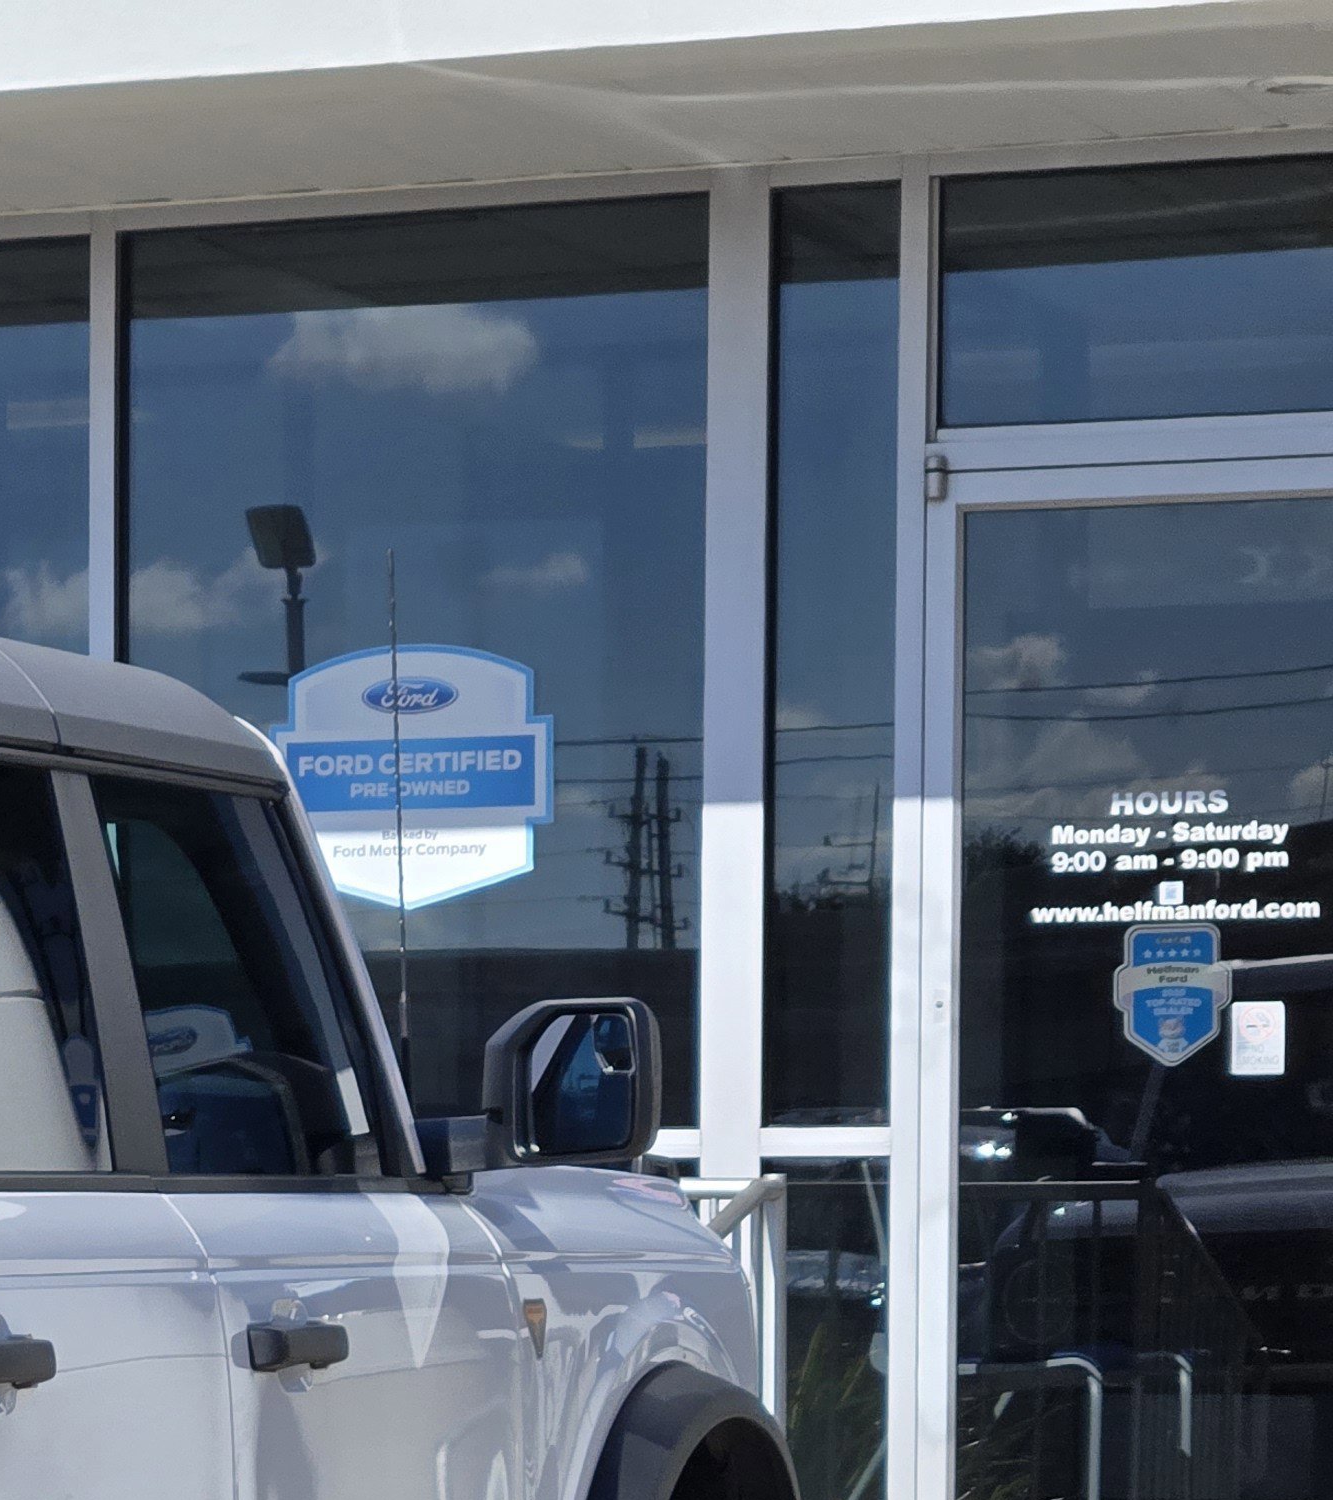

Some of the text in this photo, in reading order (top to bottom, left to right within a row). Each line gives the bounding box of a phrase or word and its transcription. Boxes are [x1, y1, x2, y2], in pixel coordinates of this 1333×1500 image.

[381, 678, 439, 707] Ford
[298, 749, 523, 777] FORD CERTIFIED
[350, 780, 471, 799] PRE-OWNED
[1109, 789, 1229, 816] HOURS
[382, 829, 439, 841] Baked by
[1051, 824, 1151, 847] Monday
[1172, 821, 1289, 845] Saturday
[333, 843, 487, 858] Ford Motor Company
[1051, 851, 1107, 873] 9:00
[1114, 854, 1158, 872] am
[1180, 849, 1239, 870] 9:00
[1246, 849, 1289, 872] pm
[1031, 900, 1321, 923] www.helfmanford.com
[1158, 974, 1188, 984] Ford
